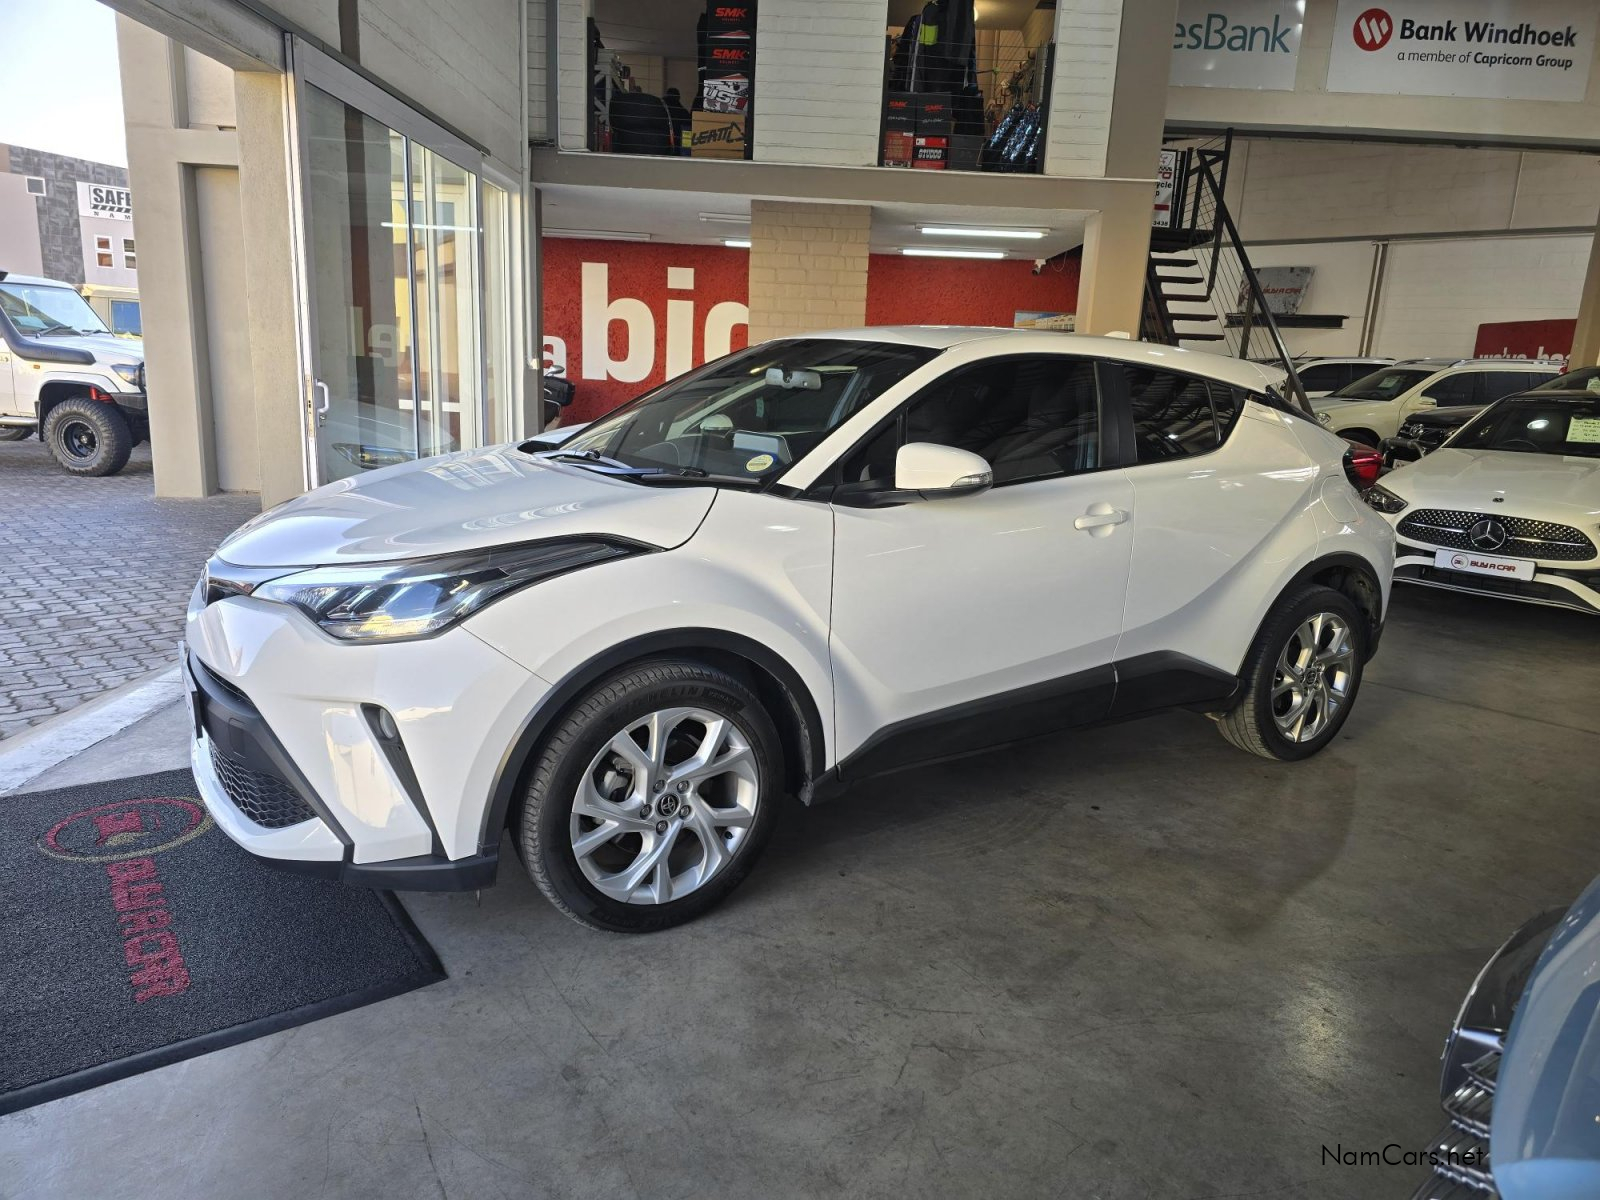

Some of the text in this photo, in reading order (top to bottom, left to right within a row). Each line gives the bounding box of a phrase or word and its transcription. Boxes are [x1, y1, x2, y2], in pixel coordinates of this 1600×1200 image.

[714, 7, 748, 18] SMK
[1399, 18, 1578, 48] Bank Windhoek
[711, 48, 746, 60] SMK
[1397, 50, 1573, 71] a member of Capricorn Group
[1470, 560, 1489, 569] BUY
[1496, 564, 1516, 573] CAR
